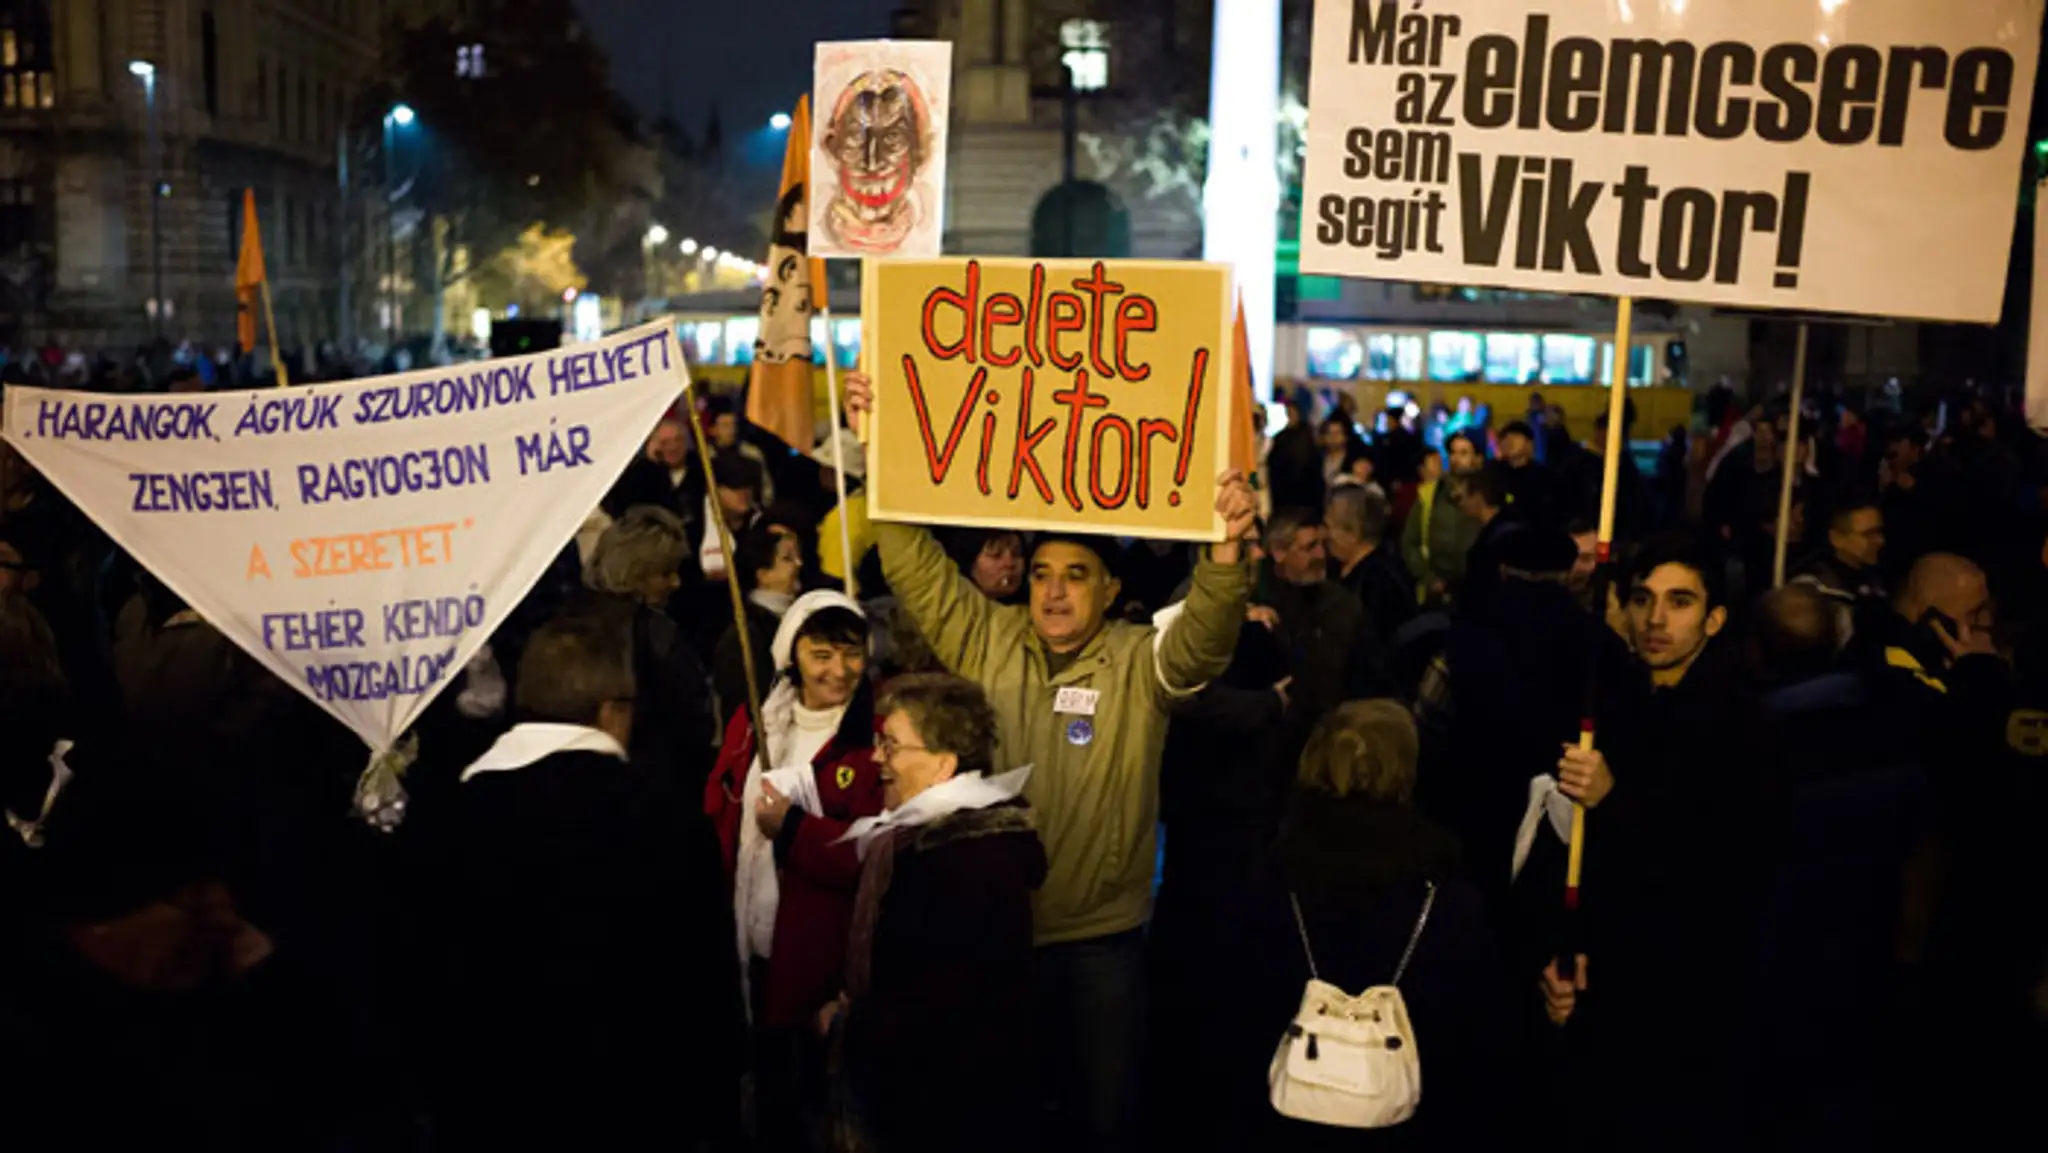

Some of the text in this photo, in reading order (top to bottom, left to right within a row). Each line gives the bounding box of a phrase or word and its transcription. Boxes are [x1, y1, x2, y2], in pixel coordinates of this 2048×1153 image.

[1348, 0, 1461, 67] Már
[1395, 71, 1457, 126] az
[1462, 14, 2014, 151] elemcsere
[1343, 127, 1451, 183] sem
[1317, 188, 1447, 260] segít
[1457, 152, 1811, 288] Viktor!
[921, 259, 1158, 382] delete
[353, 362, 535, 423] SZURONYOK
[547, 328, 670, 396] HELYETT
[515, 417, 593, 476] MÁR
[902, 346, 1210, 512] Viktor!
[245, 542, 273, 581] A
